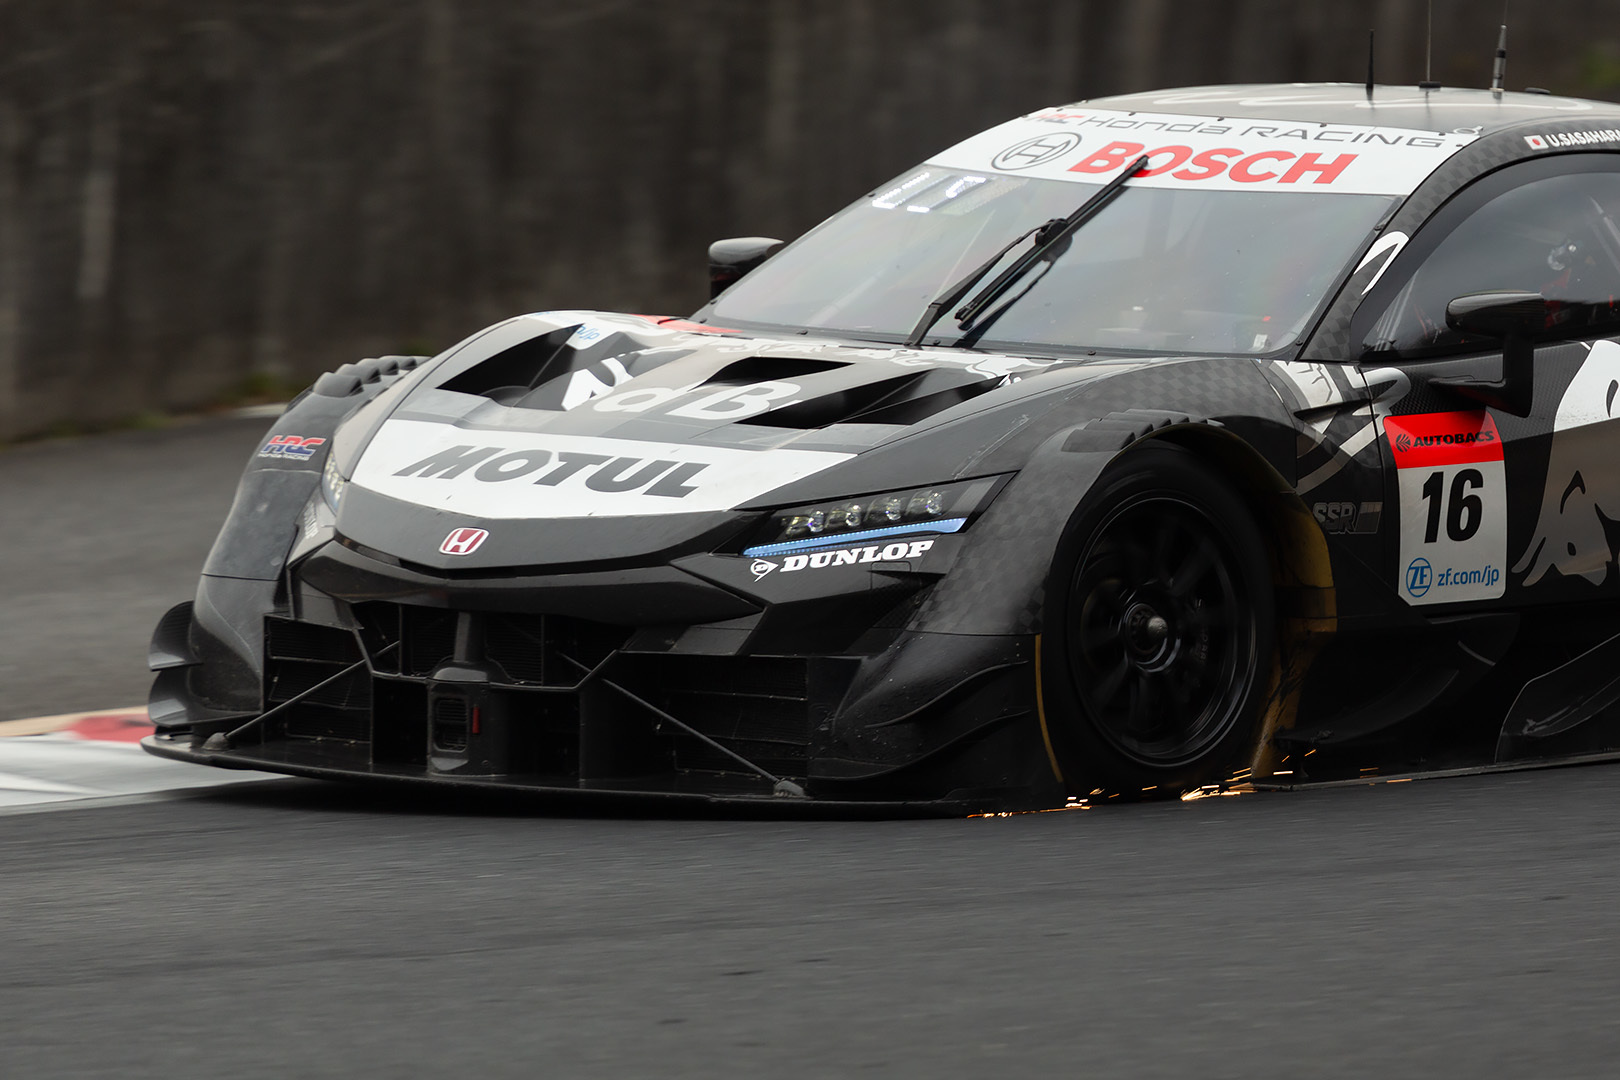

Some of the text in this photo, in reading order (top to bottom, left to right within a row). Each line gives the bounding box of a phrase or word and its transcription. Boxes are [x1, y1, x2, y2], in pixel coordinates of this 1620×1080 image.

[1078, 116, 1232, 135] Honda
[1241, 124, 1441, 148] RACING
[1068, 141, 1358, 184] BOSCH
[260, 435, 327, 457] HRC
[1414, 431, 1495, 447] AUTOBACS
[392, 445, 710, 498] MOTUL
[1313, 501, 1357, 532] SSR
[1422, 469, 1484, 544] 16
[779, 540, 935, 572] DUNLOP
[1438, 565, 1500, 587] zf.com/jp
